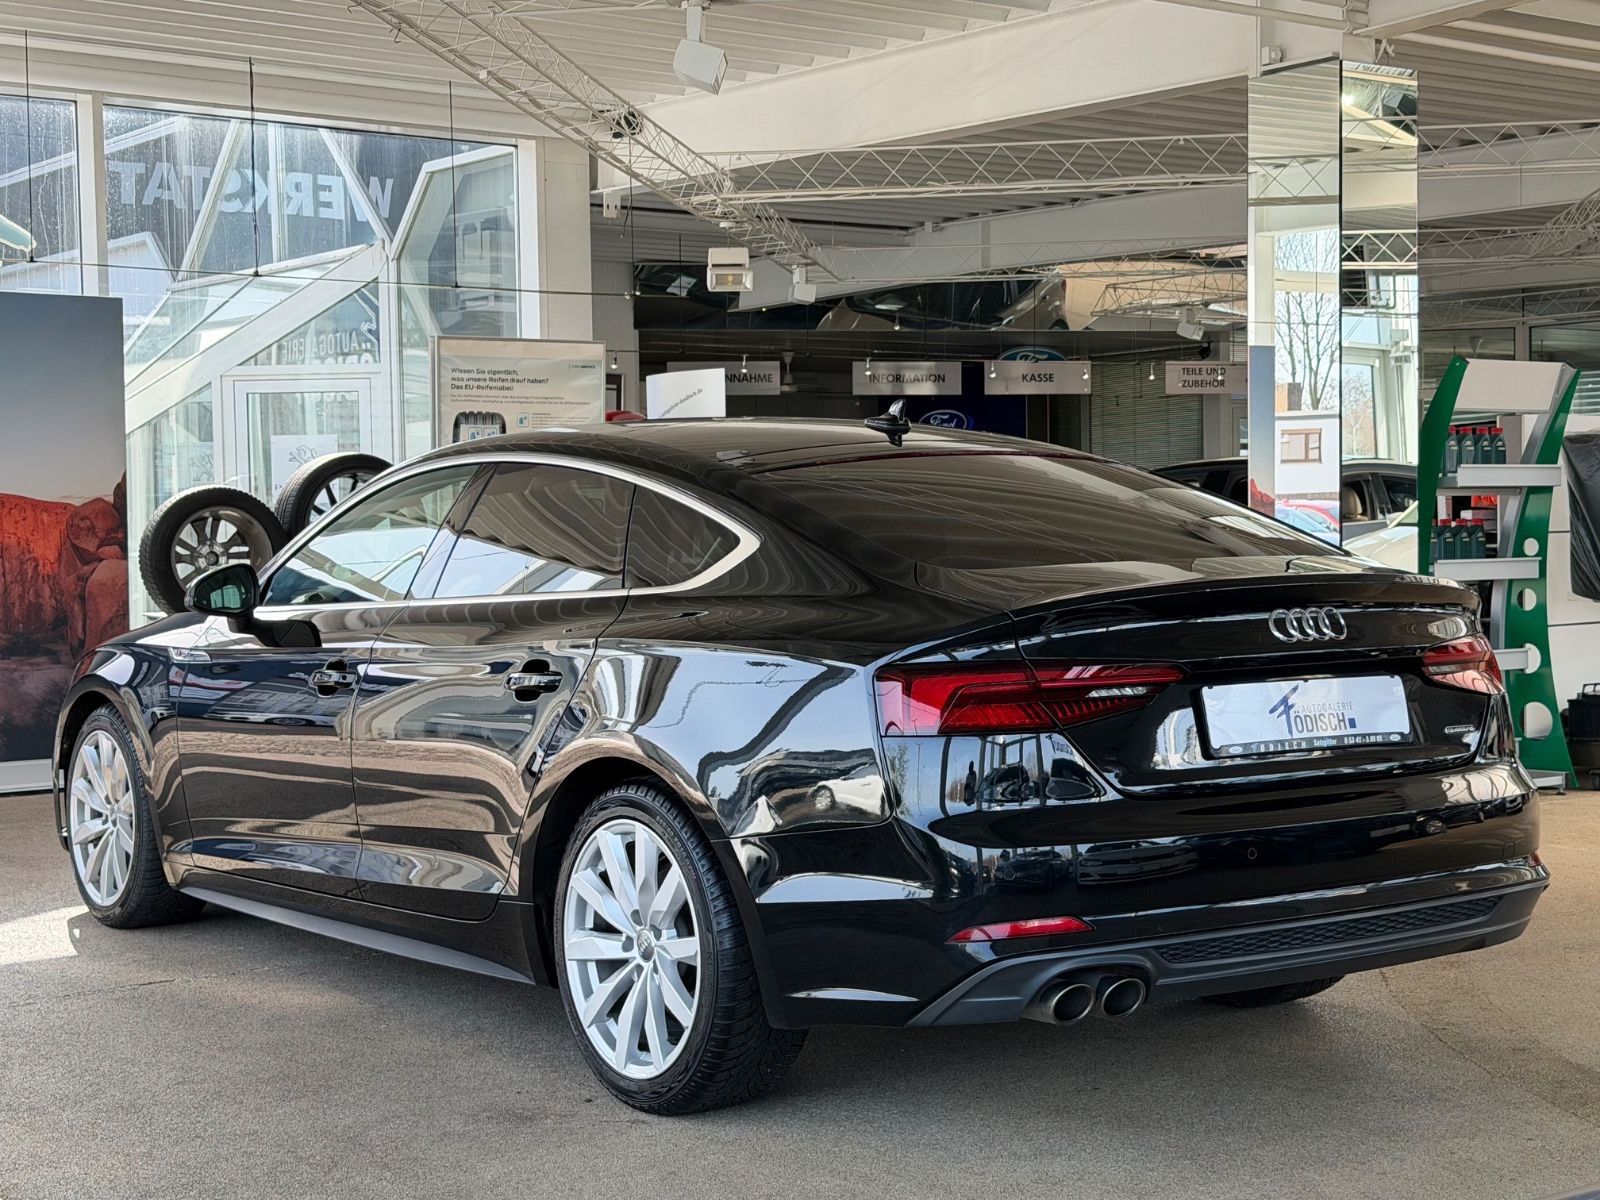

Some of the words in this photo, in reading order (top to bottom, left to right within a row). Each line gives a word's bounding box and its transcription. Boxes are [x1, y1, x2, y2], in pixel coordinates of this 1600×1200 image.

[451, 367, 474, 375] Wissen
[1181, 367, 1203, 376] TEILE
[1205, 367, 1226, 376] UND
[869, 373, 946, 384] INFORMATION
[1021, 373, 1055, 383] KASSE
[1181, 378, 1226, 388] ZUBEHÖR
[1301, 701, 1354, 714] AUTOGALERIE
